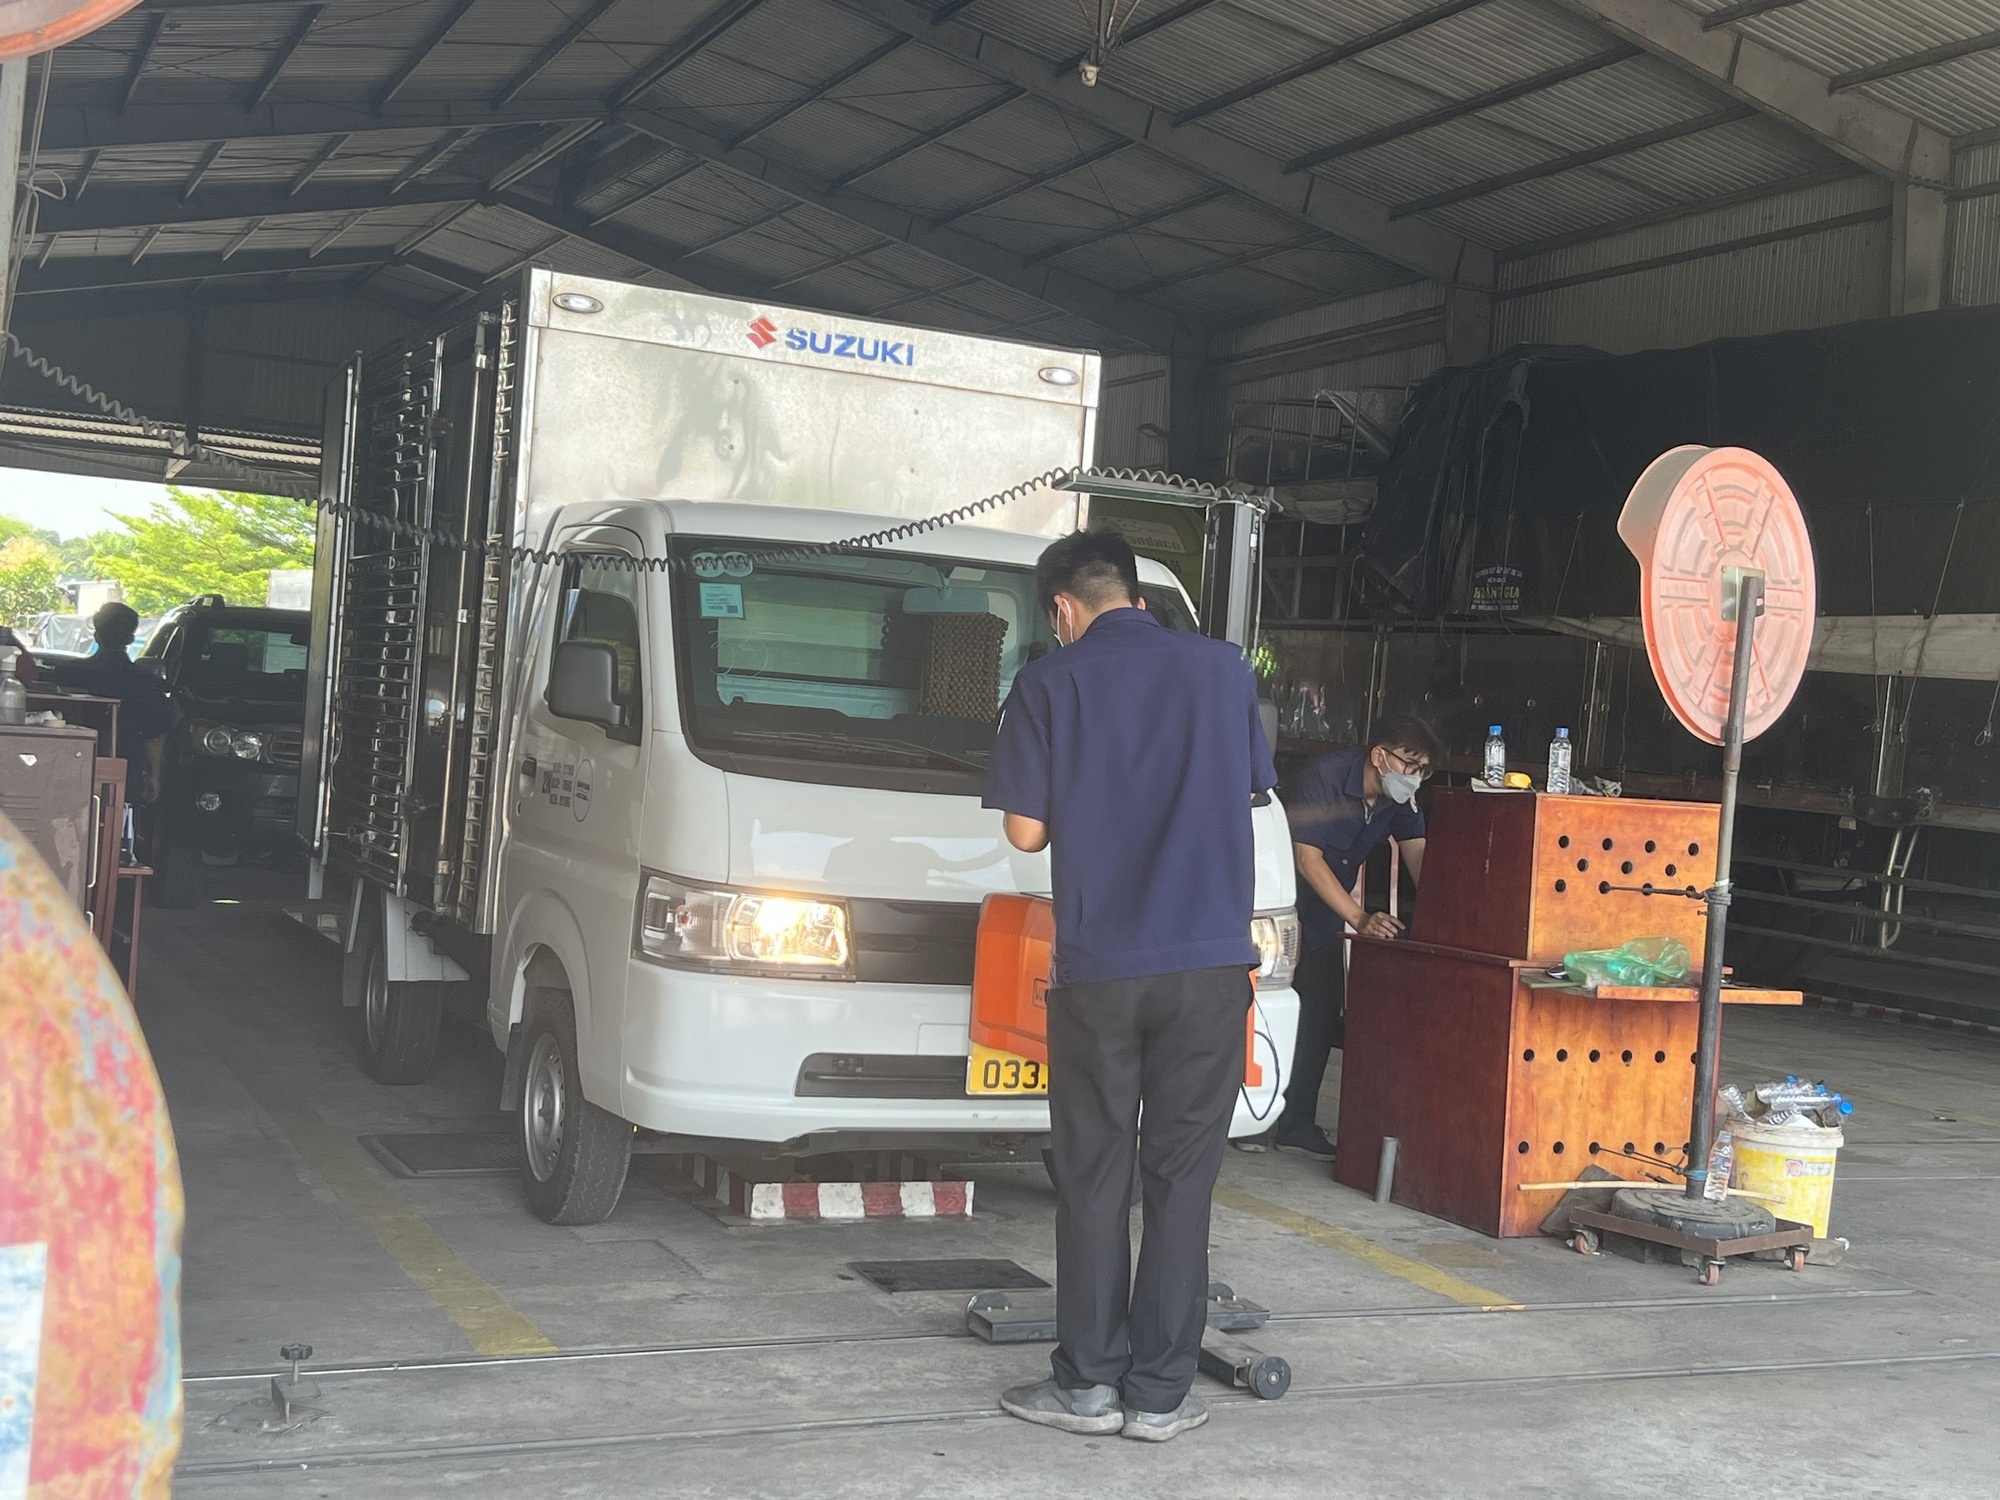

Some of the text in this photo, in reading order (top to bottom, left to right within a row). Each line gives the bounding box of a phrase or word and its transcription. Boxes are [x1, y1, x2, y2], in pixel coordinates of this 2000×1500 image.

[785, 327, 914, 366] SUZUKI
[1127, 535, 1182, 551] andaco
[1503, 586, 1520, 599] GIA
[983, 1059, 1047, 1089] 033.
